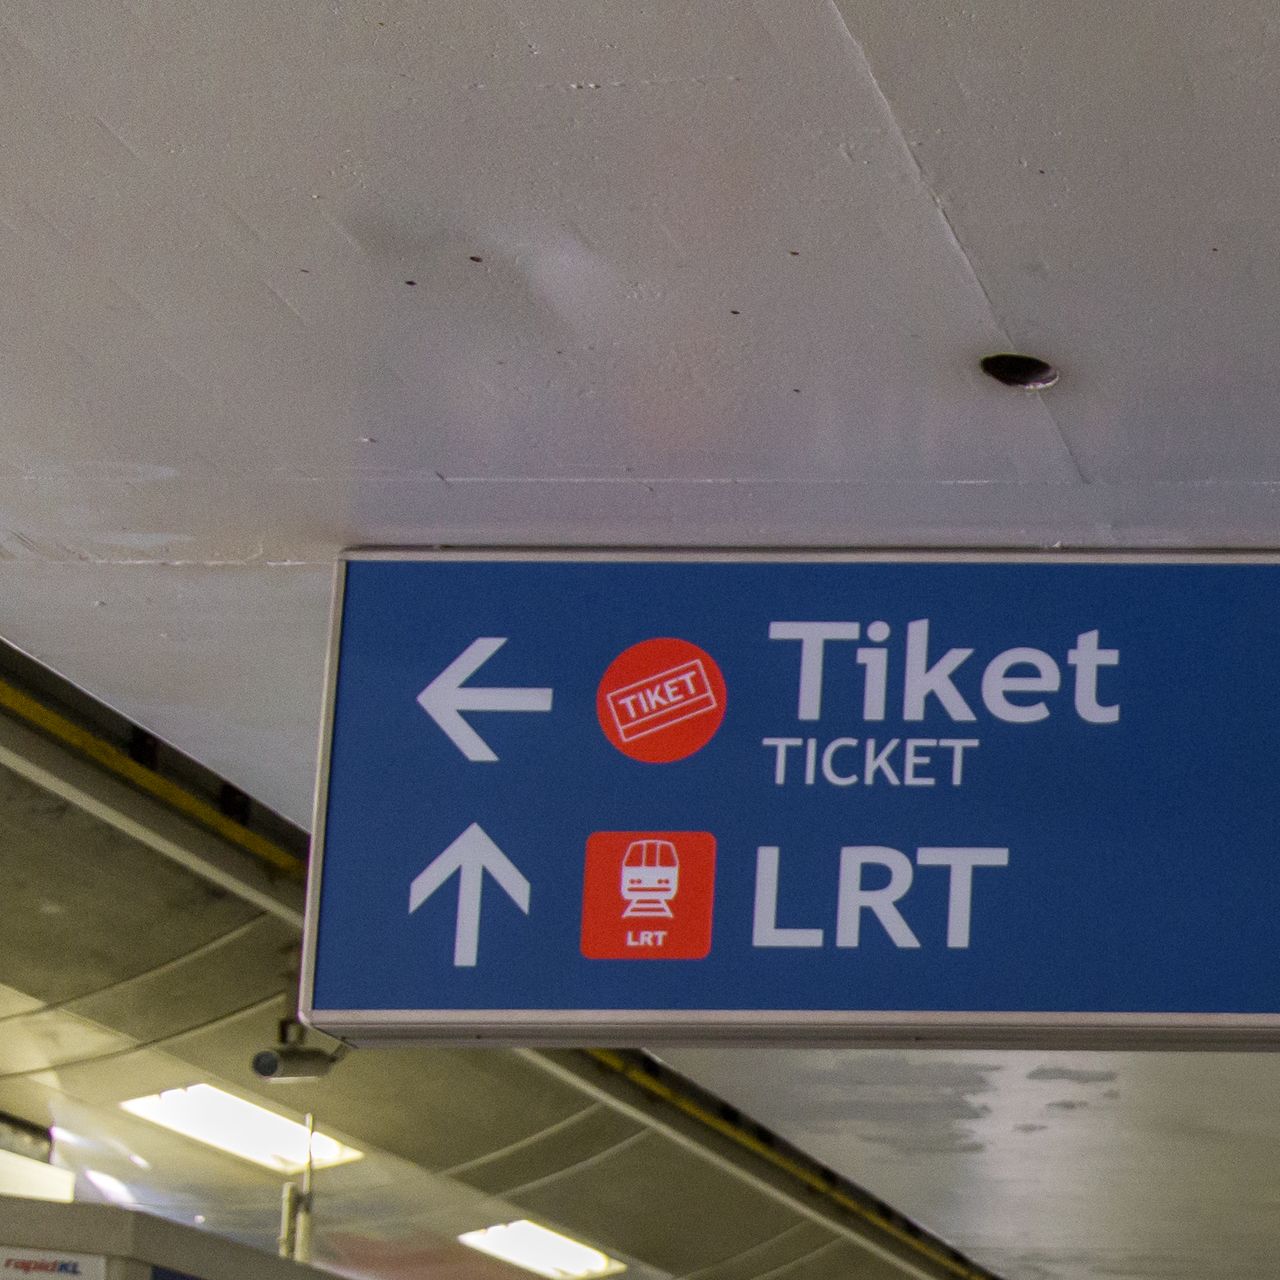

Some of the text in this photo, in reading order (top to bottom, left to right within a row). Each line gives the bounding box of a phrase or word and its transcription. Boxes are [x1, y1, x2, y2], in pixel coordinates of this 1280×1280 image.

[618, 670, 700, 720] TIKET
[769, 618, 1120, 724] Tiket
[761, 737, 980, 786] TICKET
[752, 846, 1009, 949] LRT
[626, 930, 667, 947] LRT
[4, 1258, 80, 1275] rapidKL
